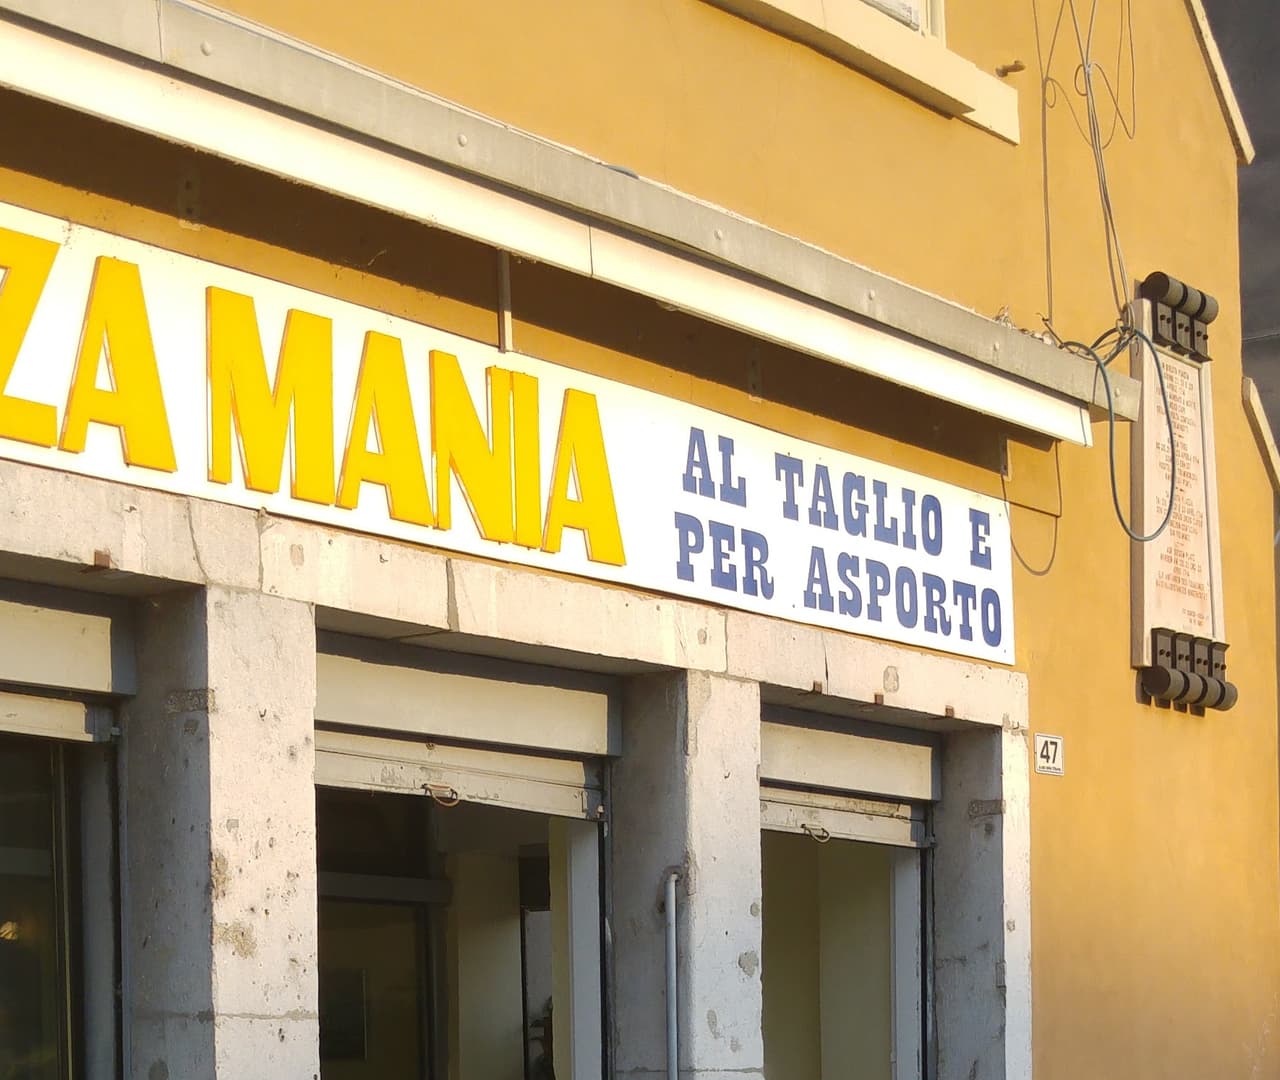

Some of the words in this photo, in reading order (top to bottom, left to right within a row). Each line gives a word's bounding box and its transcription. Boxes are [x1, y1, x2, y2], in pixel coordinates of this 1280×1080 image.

[204, 284, 627, 568] MANIA
[682, 426, 747, 508] AL
[774, 451, 943, 557] TAGLIO
[969, 507, 992, 571] E
[674, 511, 775, 600] PER
[803, 545, 1003, 648] ASPORTO
[1040, 740, 1058, 764] 47
